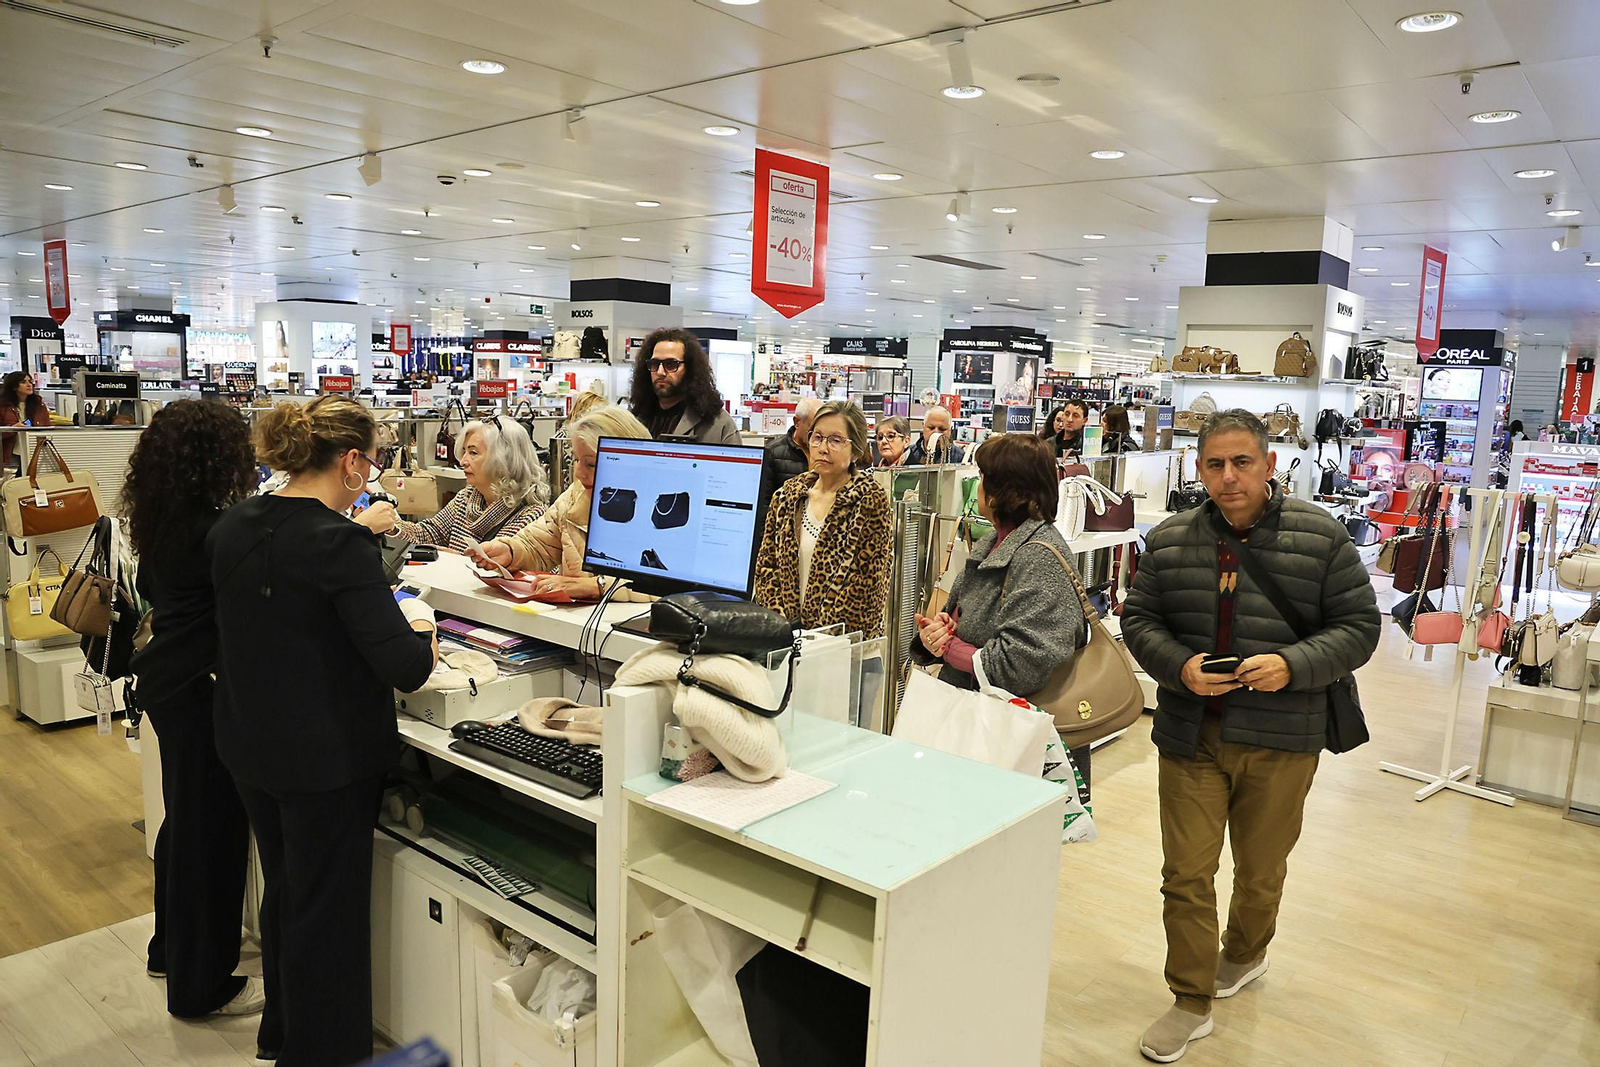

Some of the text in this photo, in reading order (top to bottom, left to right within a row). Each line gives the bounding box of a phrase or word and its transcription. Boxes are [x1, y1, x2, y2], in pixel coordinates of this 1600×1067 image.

[783, 182, 804, 193] oferta
[771, 206, 798, 217] Selección
[770, 237, 812, 262] -40%
[571, 310, 593, 318] BOLSOS
[135, 315, 174, 323] CHANEL
[31, 328, 57, 338] Dior
[476, 342, 501, 350] CLARINS
[507, 343, 541, 351] CLARINS
[1429, 347, 1490, 360] ORÉAL
[1582, 361, 1588, 370] 1
[479, 384, 504, 393] rebajas
[1010, 414, 1030, 424] GUESS
[1158, 412, 1172, 421] GUESS
[769, 418, 785, 426] -40%
[1552, 445, 1600, 456] MAVA
